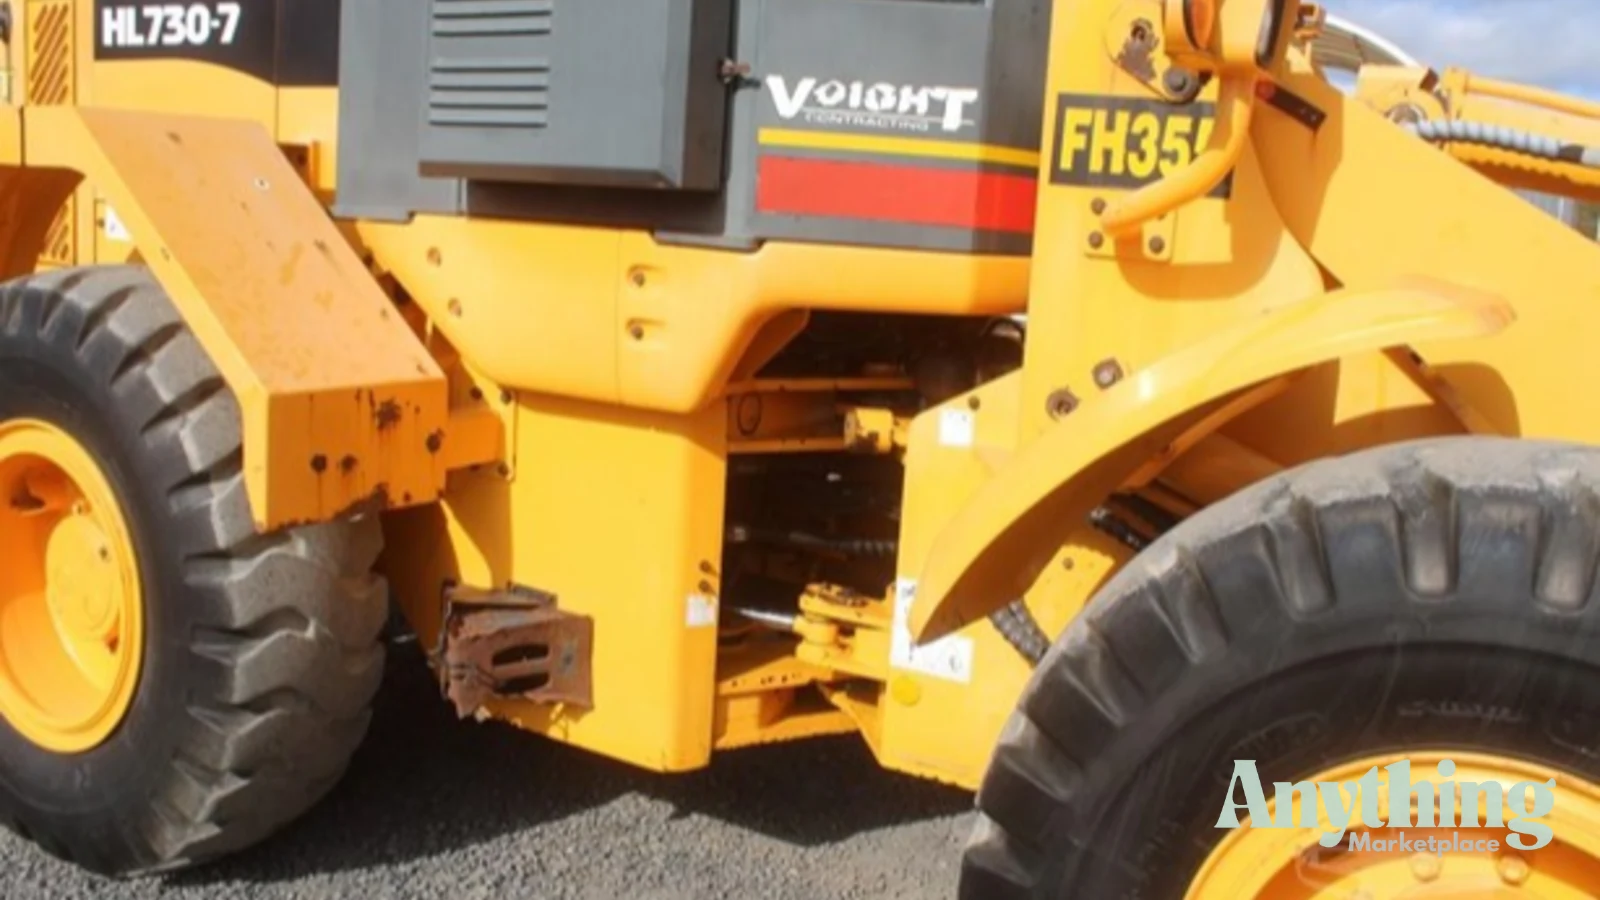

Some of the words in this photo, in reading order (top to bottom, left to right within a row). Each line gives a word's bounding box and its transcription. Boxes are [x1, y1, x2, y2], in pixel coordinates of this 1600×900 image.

[102, 3, 241, 46] HL730-7
[766, 74, 978, 131] VOIGHT
[804, 112, 929, 132] CONTRACTING
